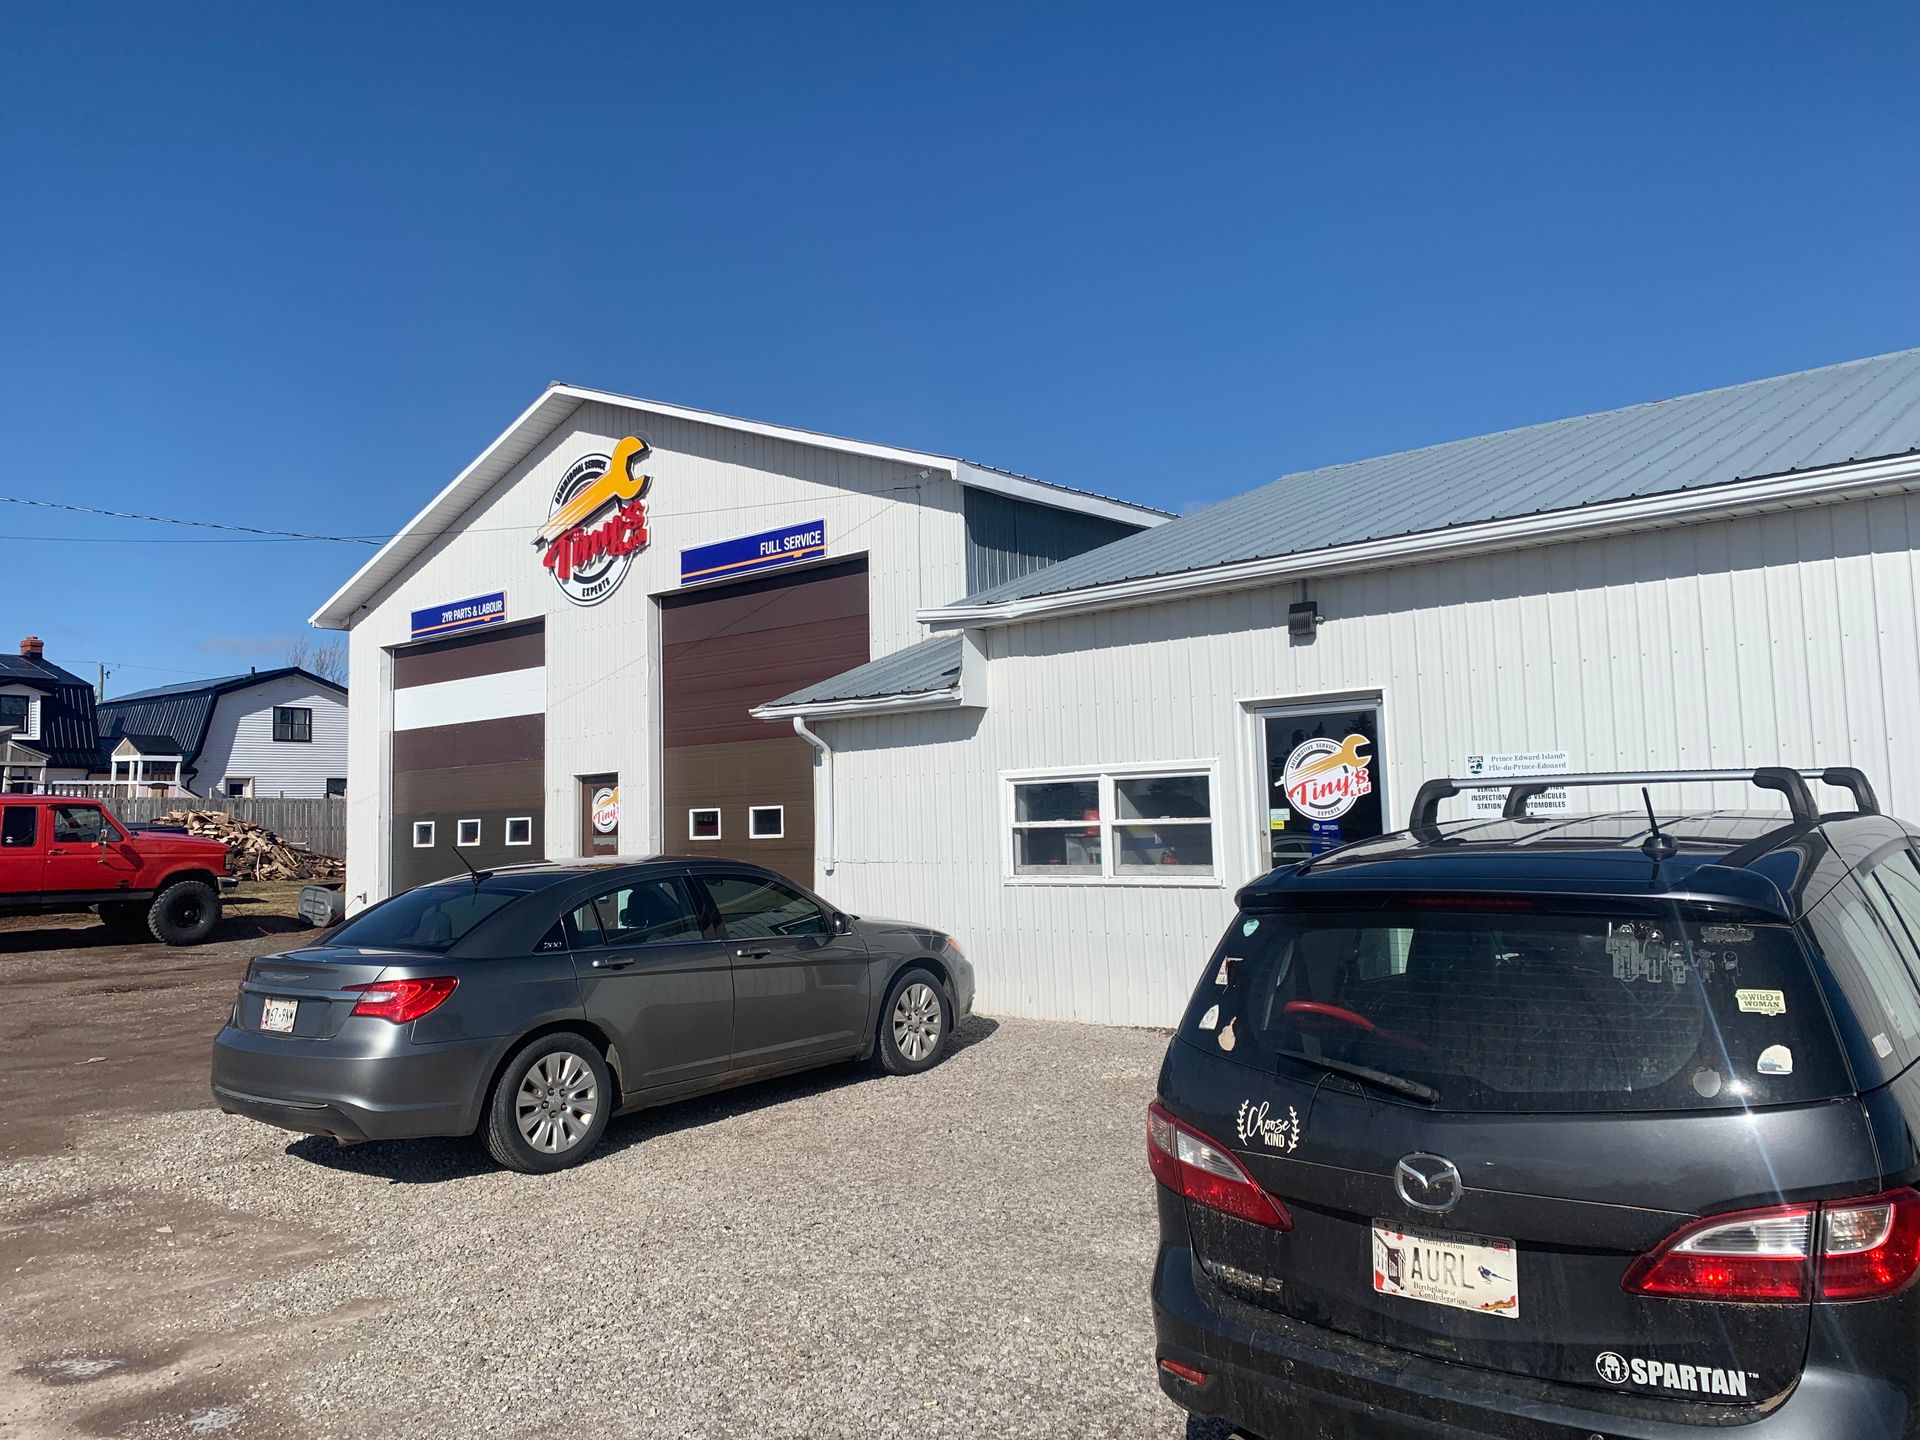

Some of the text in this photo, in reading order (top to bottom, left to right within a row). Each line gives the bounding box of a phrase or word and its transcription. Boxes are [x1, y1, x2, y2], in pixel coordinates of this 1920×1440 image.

[760, 530, 822, 556] FULL SERVICE
[582, 577, 611, 597] EXPERTS
[441, 600, 503, 623] 2YR PARTS & LABOUR
[1290, 743, 1337, 770] AUTOMOTIVE SERVICE
[1287, 769, 1369, 805] Tiny's
[1350, 784, 1370, 797] Ltd
[1317, 806, 1341, 817] EXPERTS
[1526, 801, 1566, 809] UTOMOBILES
[1748, 993, 1774, 1001] WILD
[1247, 1101, 1291, 1138] Choose
[1264, 1131, 1285, 1148] KIND
[1410, 1228, 1474, 1244] Prince Edward Island
[1418, 1236, 1465, 1251] Conservation
[1411, 1247, 1475, 1290] AURL
[1413, 1281, 1448, 1295] Birthplace
[1418, 1290, 1468, 1306] Confederation
[1630, 1358, 1748, 1397] SPARTAN
